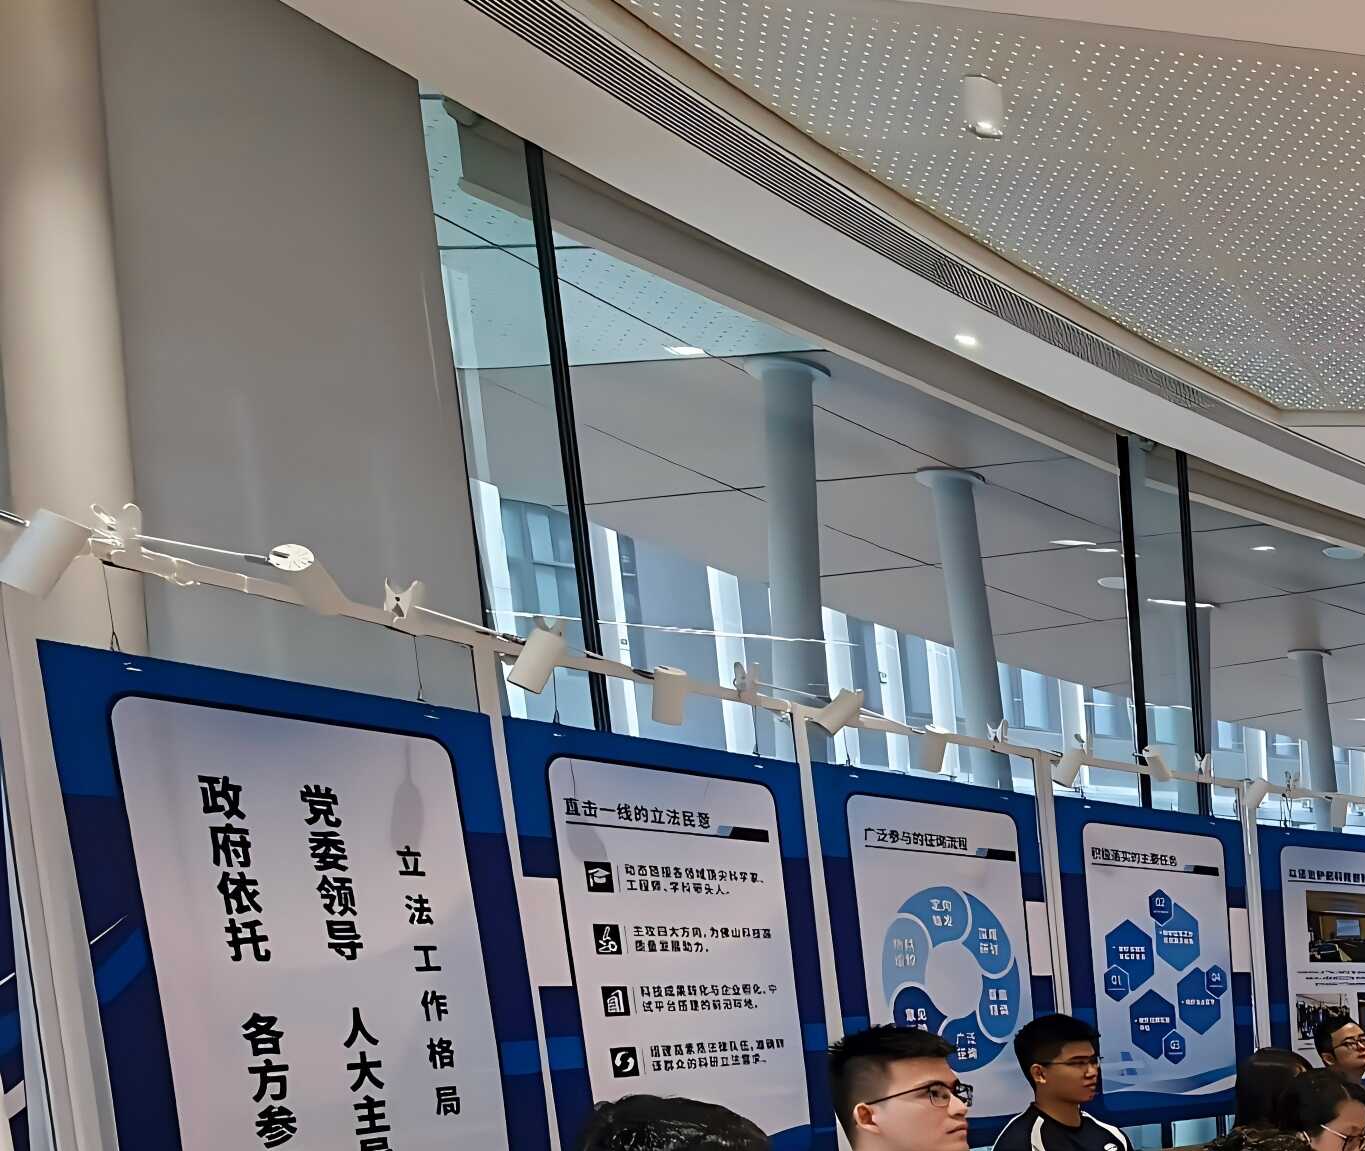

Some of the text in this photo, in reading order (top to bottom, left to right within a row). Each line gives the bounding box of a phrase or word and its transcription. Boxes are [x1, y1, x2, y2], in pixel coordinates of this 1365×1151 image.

[197, 774, 272, 964] 政府依托
[300, 784, 364, 961] 党委领导
[396, 846, 461, 1116] 立法工作格局
